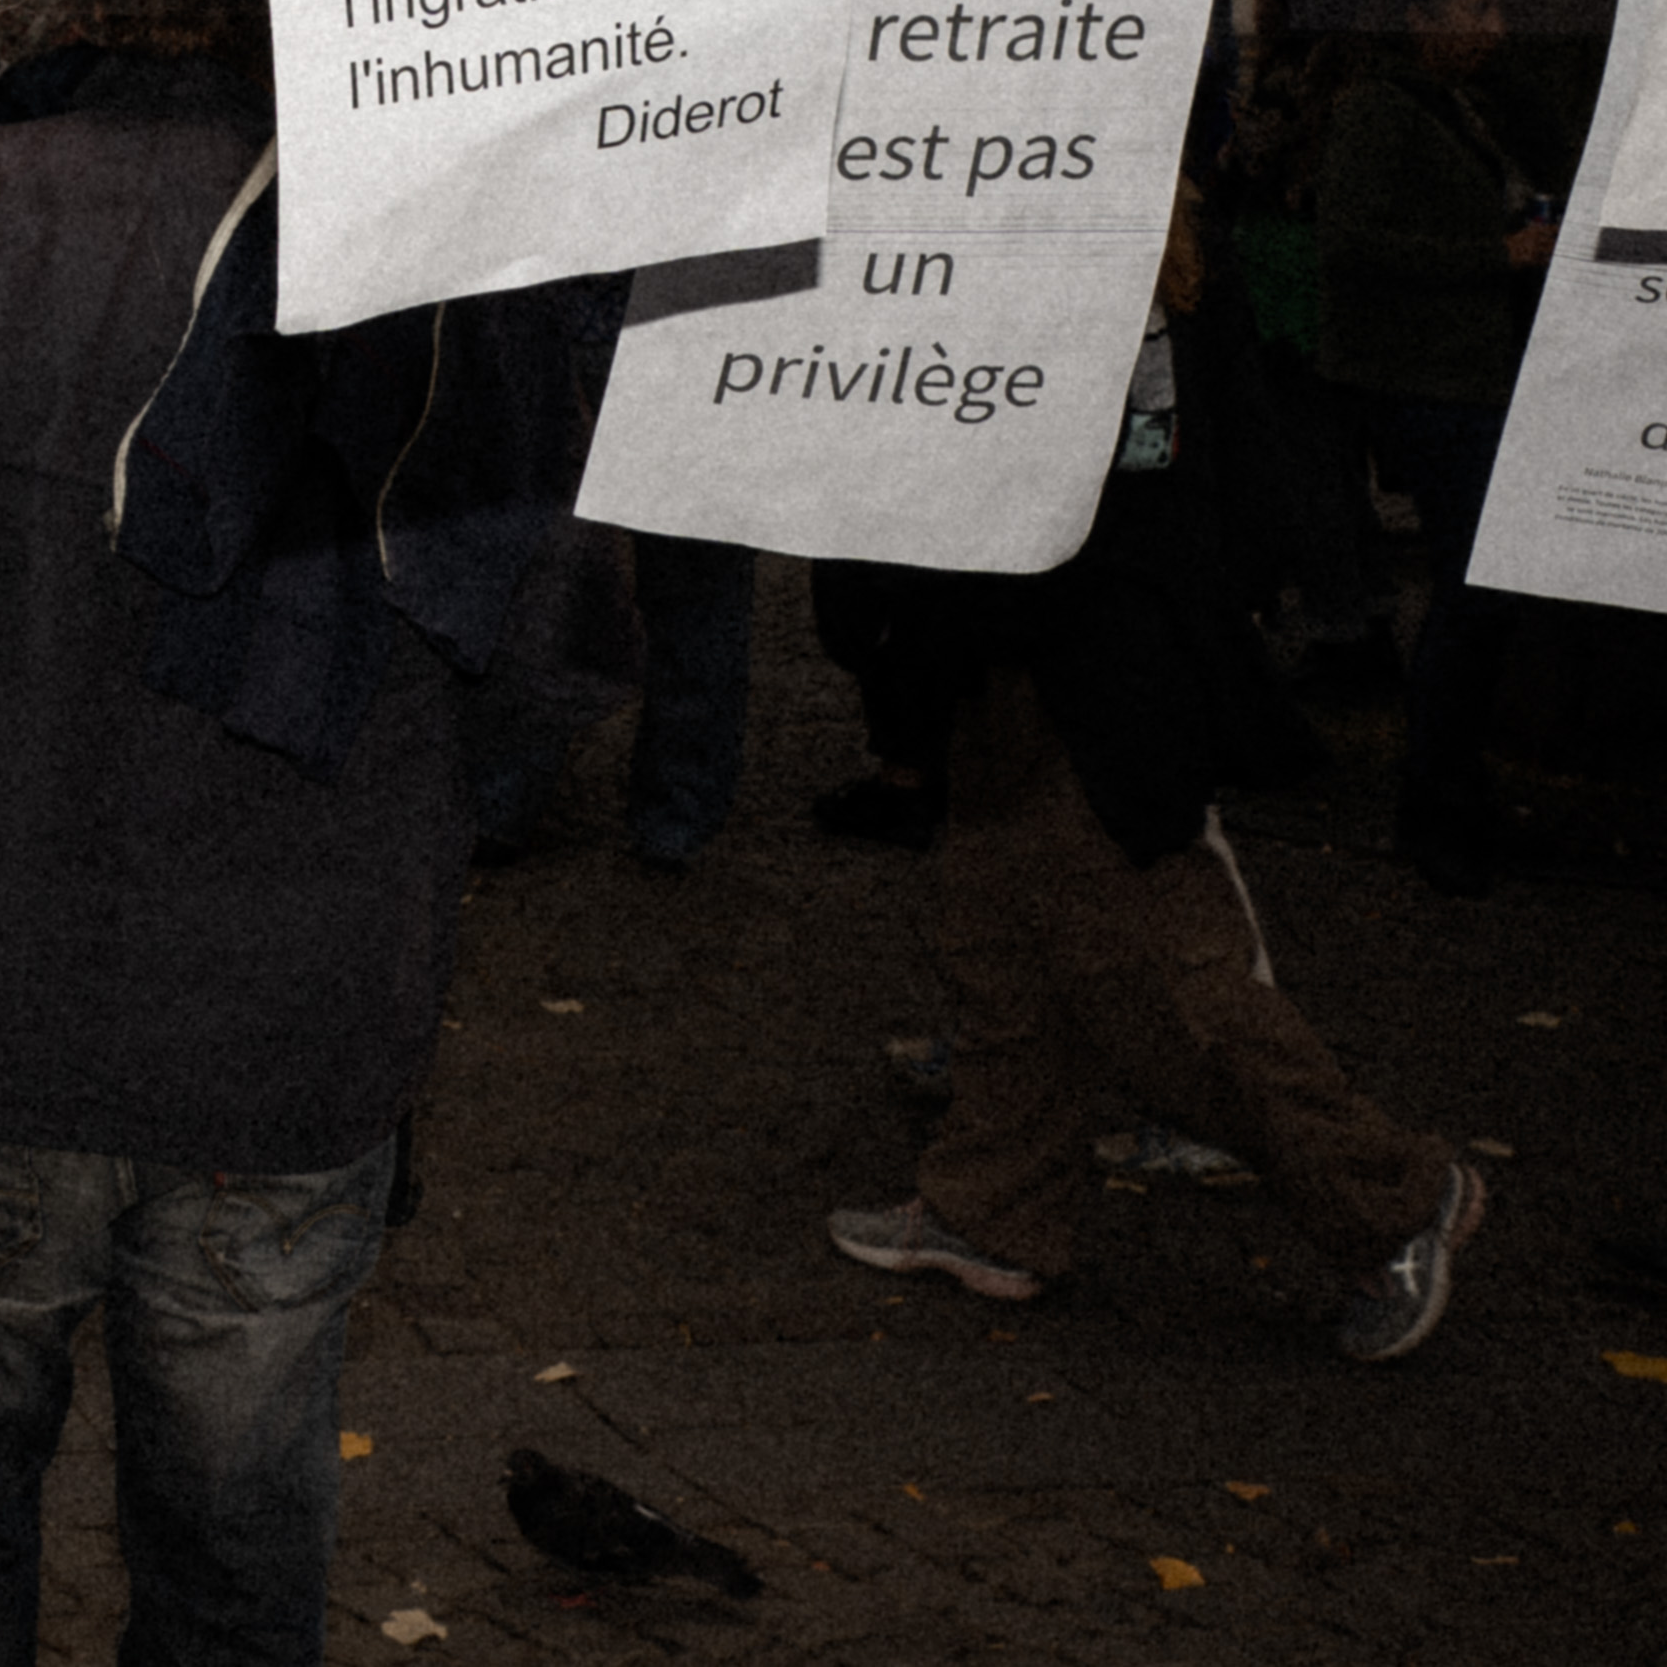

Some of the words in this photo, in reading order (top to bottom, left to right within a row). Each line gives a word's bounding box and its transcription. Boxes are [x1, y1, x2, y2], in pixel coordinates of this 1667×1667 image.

[349, 15, 690, 109] l'inhumanité.
[598, 80, 783, 148] Diderot
[837, 126, 949, 180] est
[966, 135, 1095, 196] pas
[864, 253, 953, 295] un
[714, 343, 1043, 423] privilège
